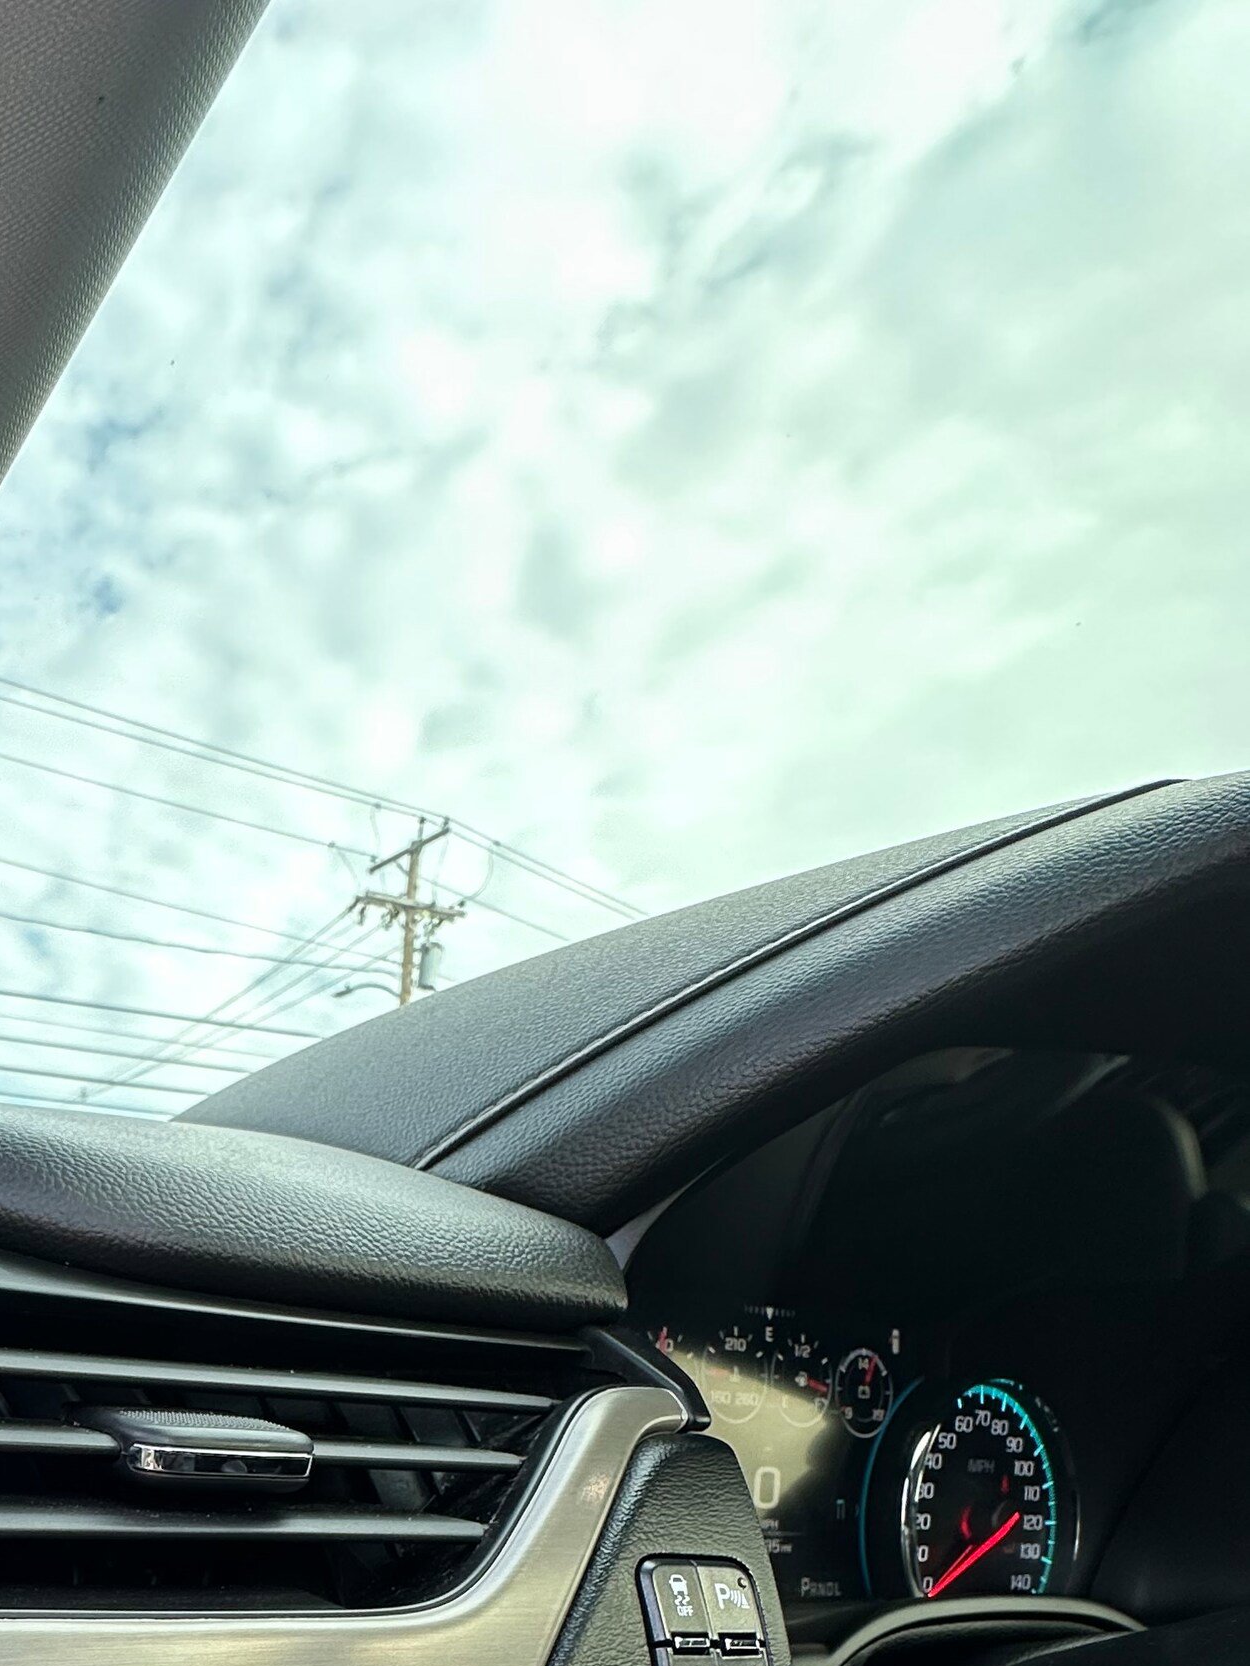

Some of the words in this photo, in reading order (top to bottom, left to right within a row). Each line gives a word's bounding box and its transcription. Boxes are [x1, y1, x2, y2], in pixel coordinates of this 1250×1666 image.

[725, 1337, 746, 1352] 210
[954, 1415, 974, 1433] 60
[975, 1409, 991, 1427] 70
[991, 1419, 1009, 1436] 80
[938, 1432, 957, 1450] 50
[1006, 1437, 1024, 1454] 90
[1014, 1460, 1035, 1477] 100
[1024, 1485, 1041, 1502] 110
[1023, 1514, 1043, 1531] 120
[1020, 1542, 1041, 1560] 130
[1011, 1574, 1031, 1591] 140
